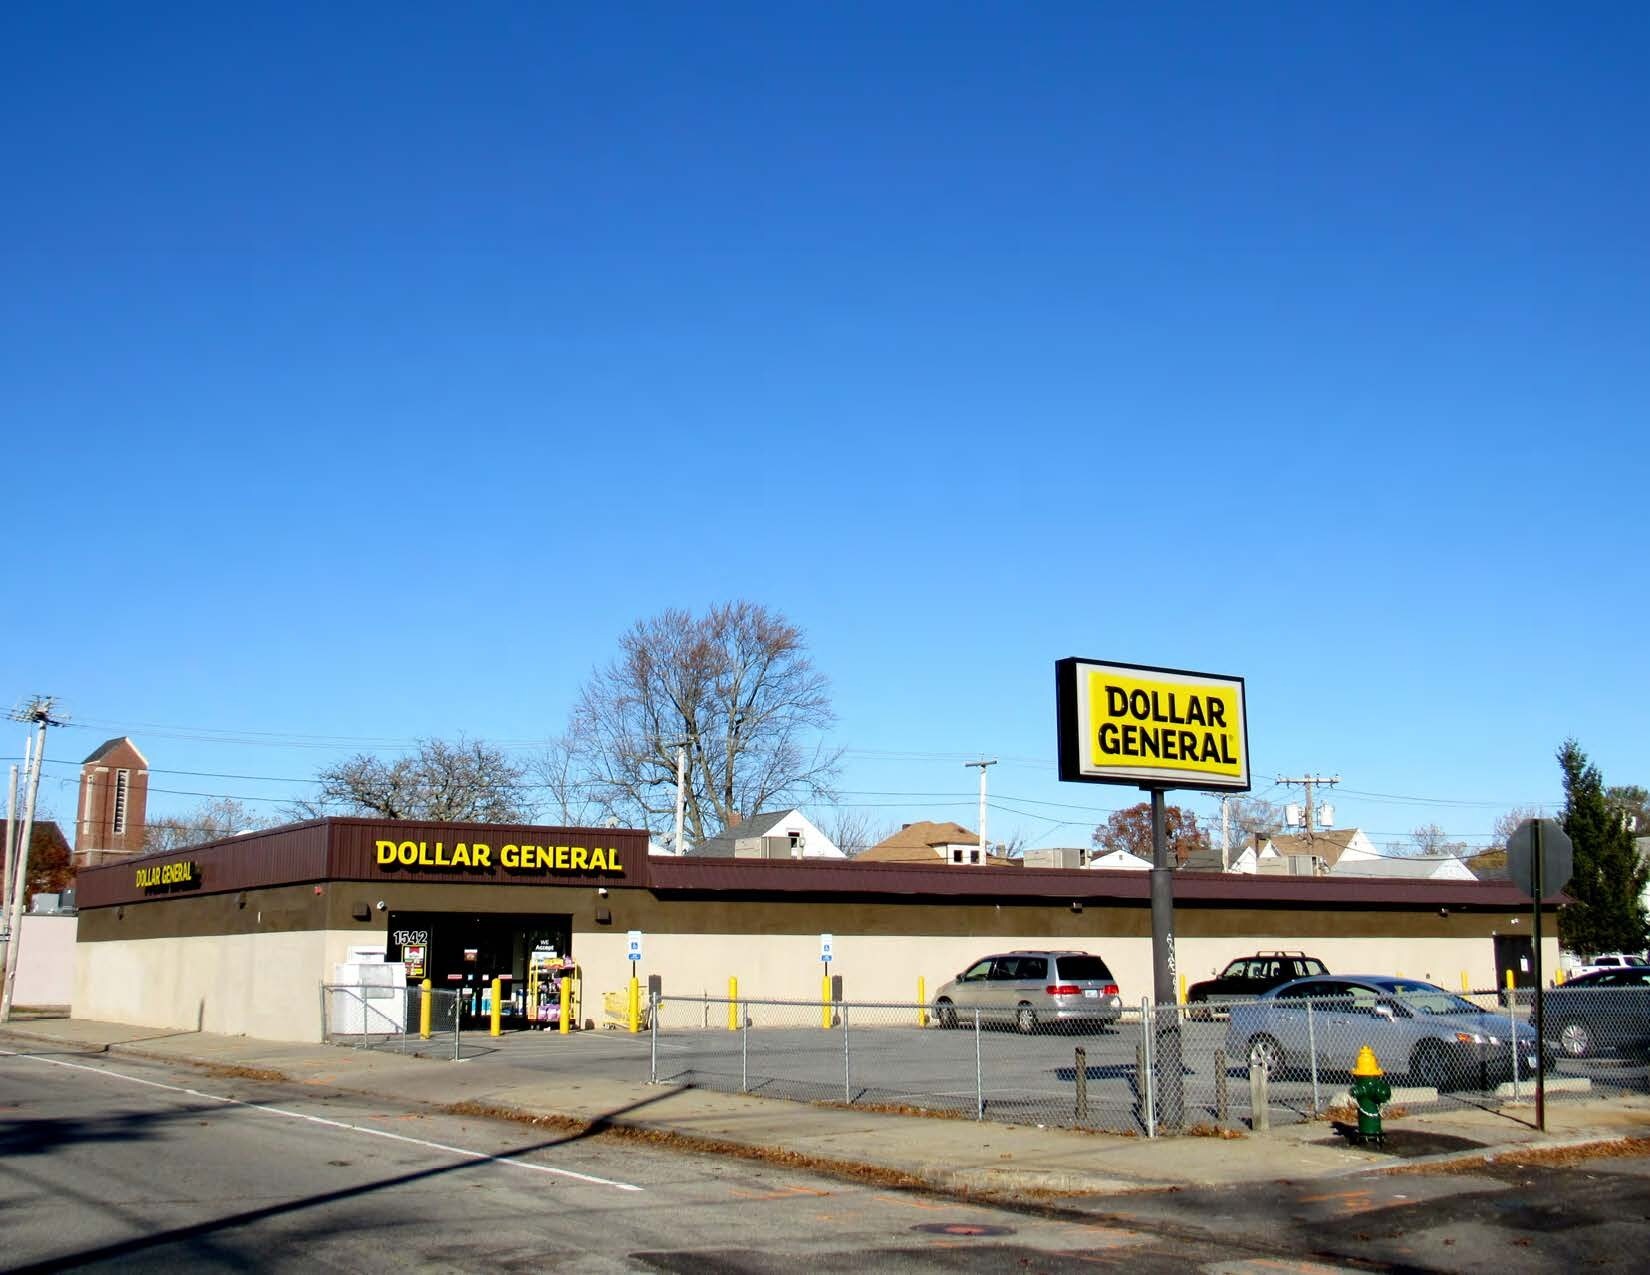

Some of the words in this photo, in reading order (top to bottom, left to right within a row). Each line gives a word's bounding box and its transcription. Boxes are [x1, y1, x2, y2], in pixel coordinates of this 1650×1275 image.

[1105, 685, 1227, 728] DOLLAR
[1098, 722, 1237, 764] GENERAL
[375, 840, 491, 867] DOLLAR
[500, 844, 623, 870] GENERAL
[135, 866, 161, 888] DOLLAR
[161, 861, 192, 884] GENERAL
[393, 930, 428, 945] 1542
